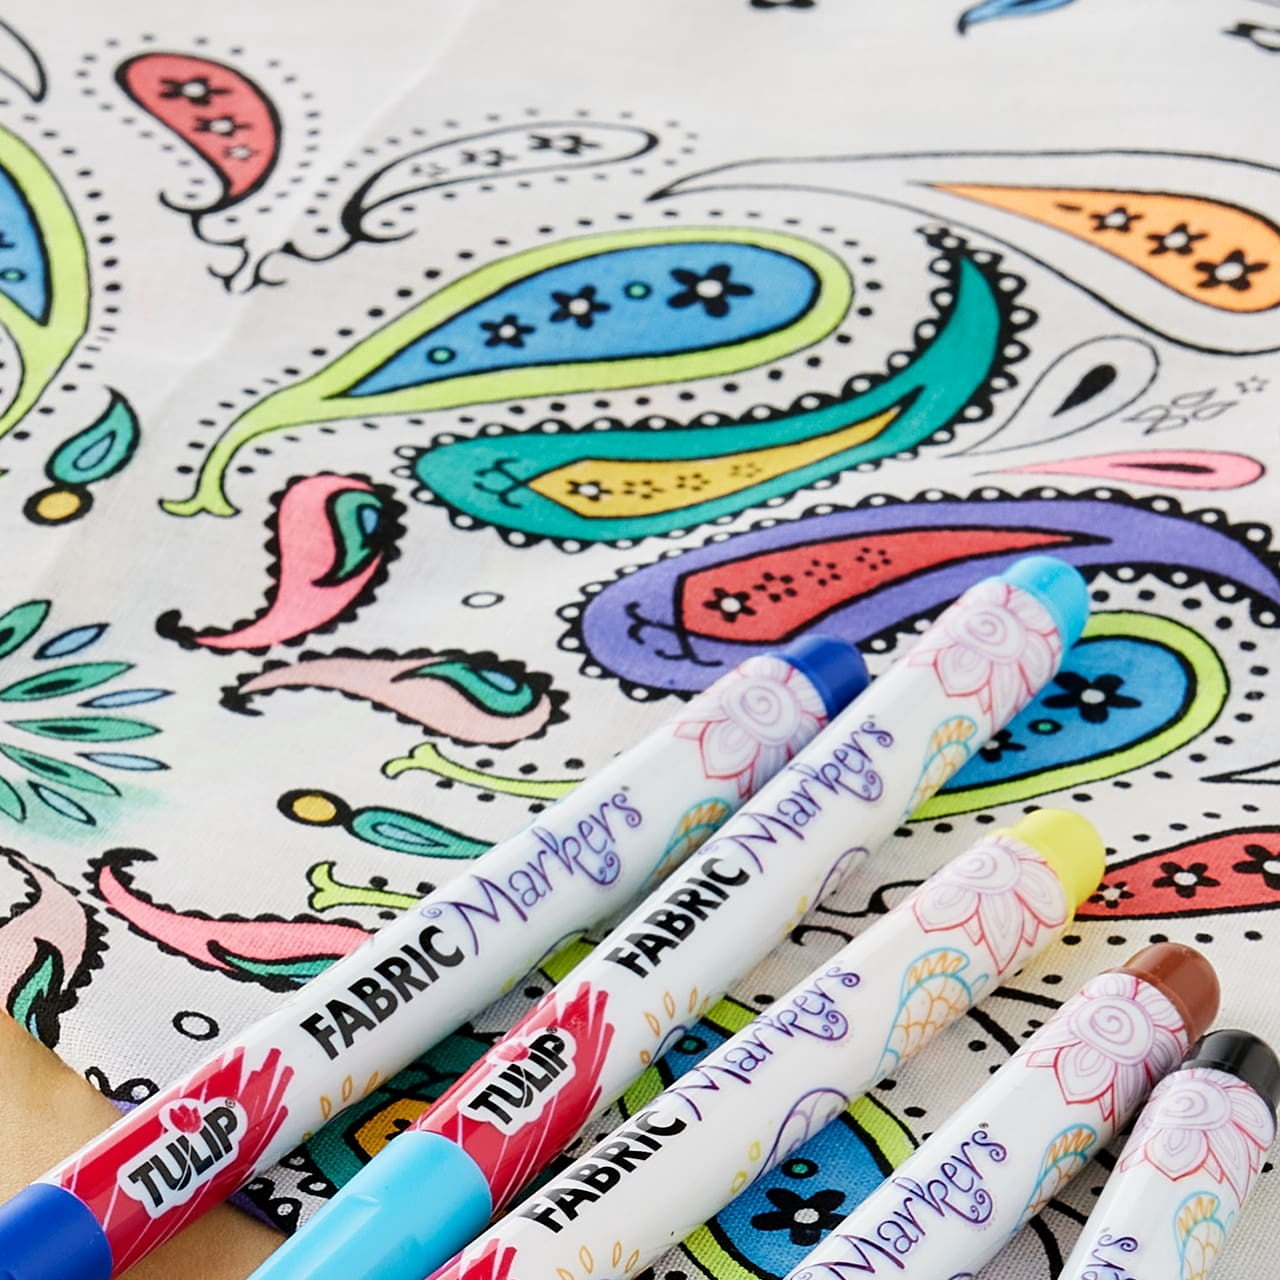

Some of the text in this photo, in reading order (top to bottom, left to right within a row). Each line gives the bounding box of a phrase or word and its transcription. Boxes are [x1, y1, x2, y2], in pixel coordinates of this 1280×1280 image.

[128, 792, 642, 1206] TULIP FABRIC Markers
[468, 720, 893, 1124] TULIP FABRIC Markers
[520, 1109, 687, 1233] FABRIC
[667, 964, 862, 1122] Markers
